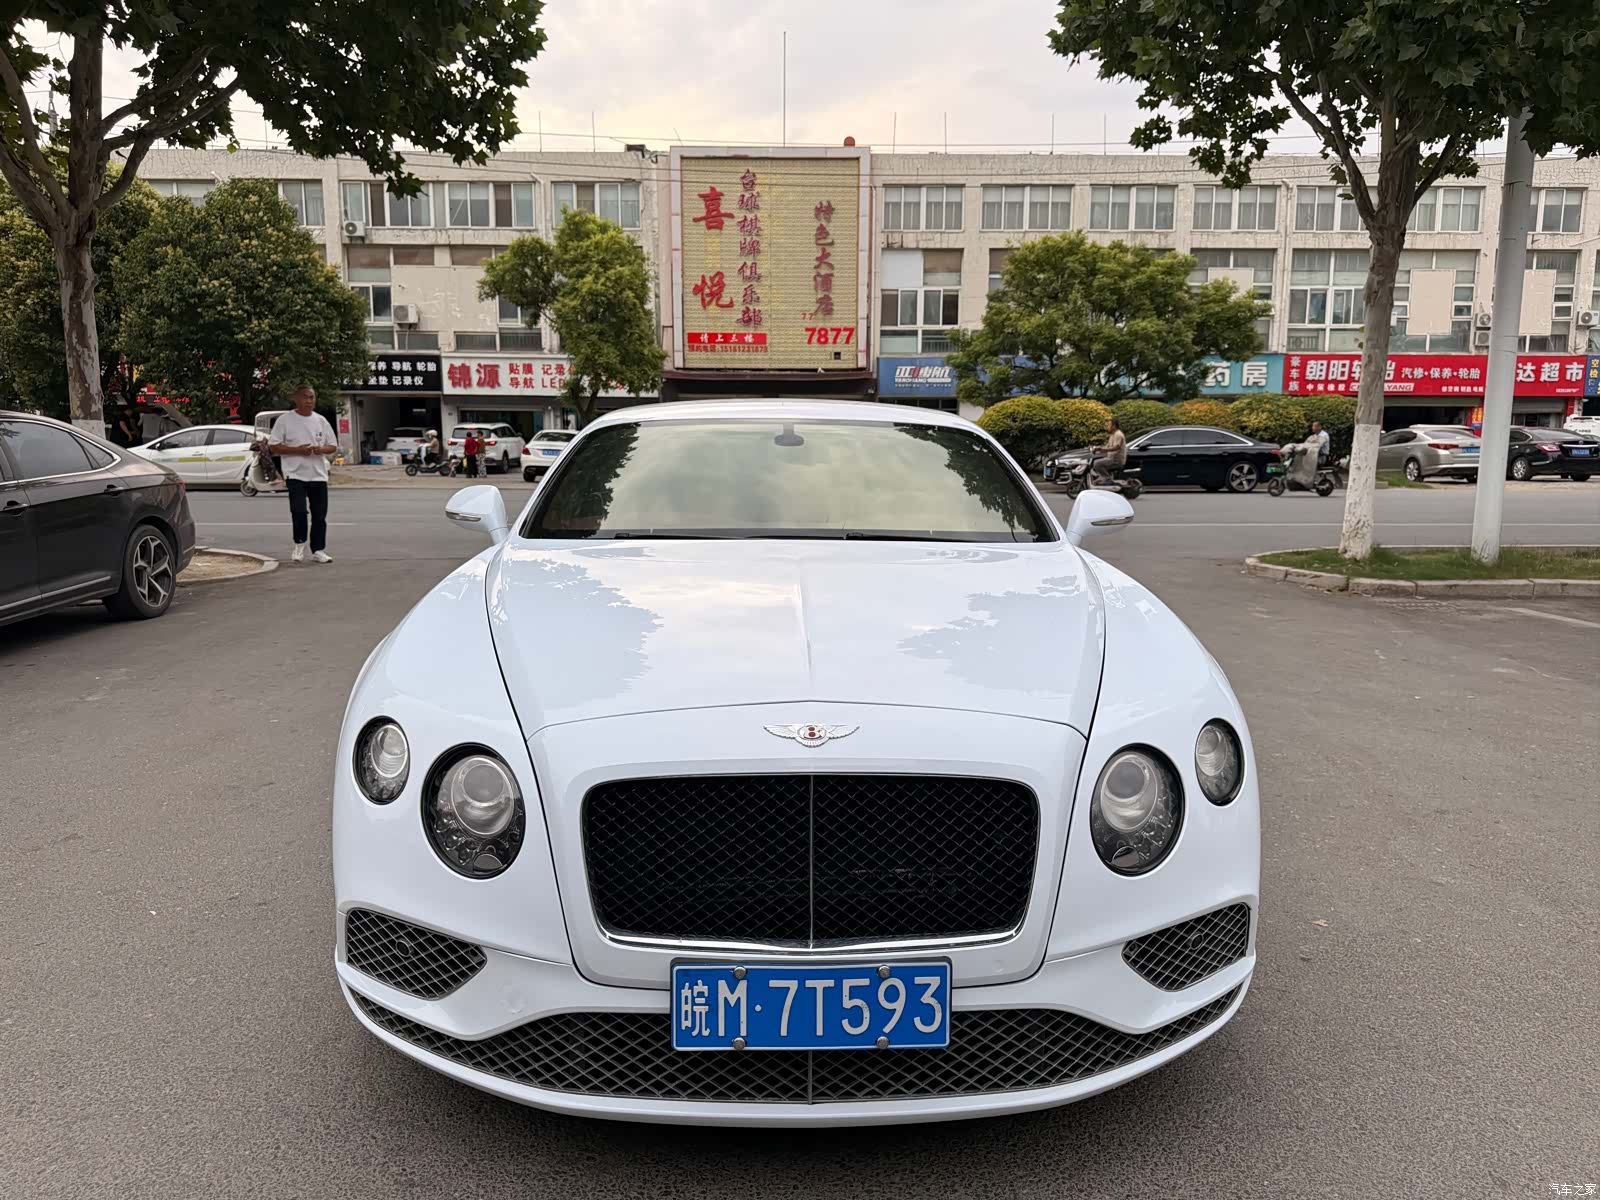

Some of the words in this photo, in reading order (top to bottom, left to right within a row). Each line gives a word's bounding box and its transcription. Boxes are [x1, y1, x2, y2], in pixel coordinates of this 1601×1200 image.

[692, 186, 735, 309] 喜悦
[736, 169, 763, 330] 台球棋牌俱乐部
[813, 200, 836, 318] 特色大酒店
[700, 333, 756, 343] 请上三楼
[804, 327, 855, 345] 7877
[416, 361, 437, 371] 轮胎
[447, 363, 501, 389] 锦源
[508, 363, 534, 375] 贴膜
[1204, 360, 1268, 387] 药房
[1288, 356, 1301, 391] 豪车族
[1516, 361, 1585, 382] 达超市
[392, 375, 424, 386] 记录仪
[509, 378, 535, 389] 导航
[681, 977, 943, 1038] 皖M·7T593
